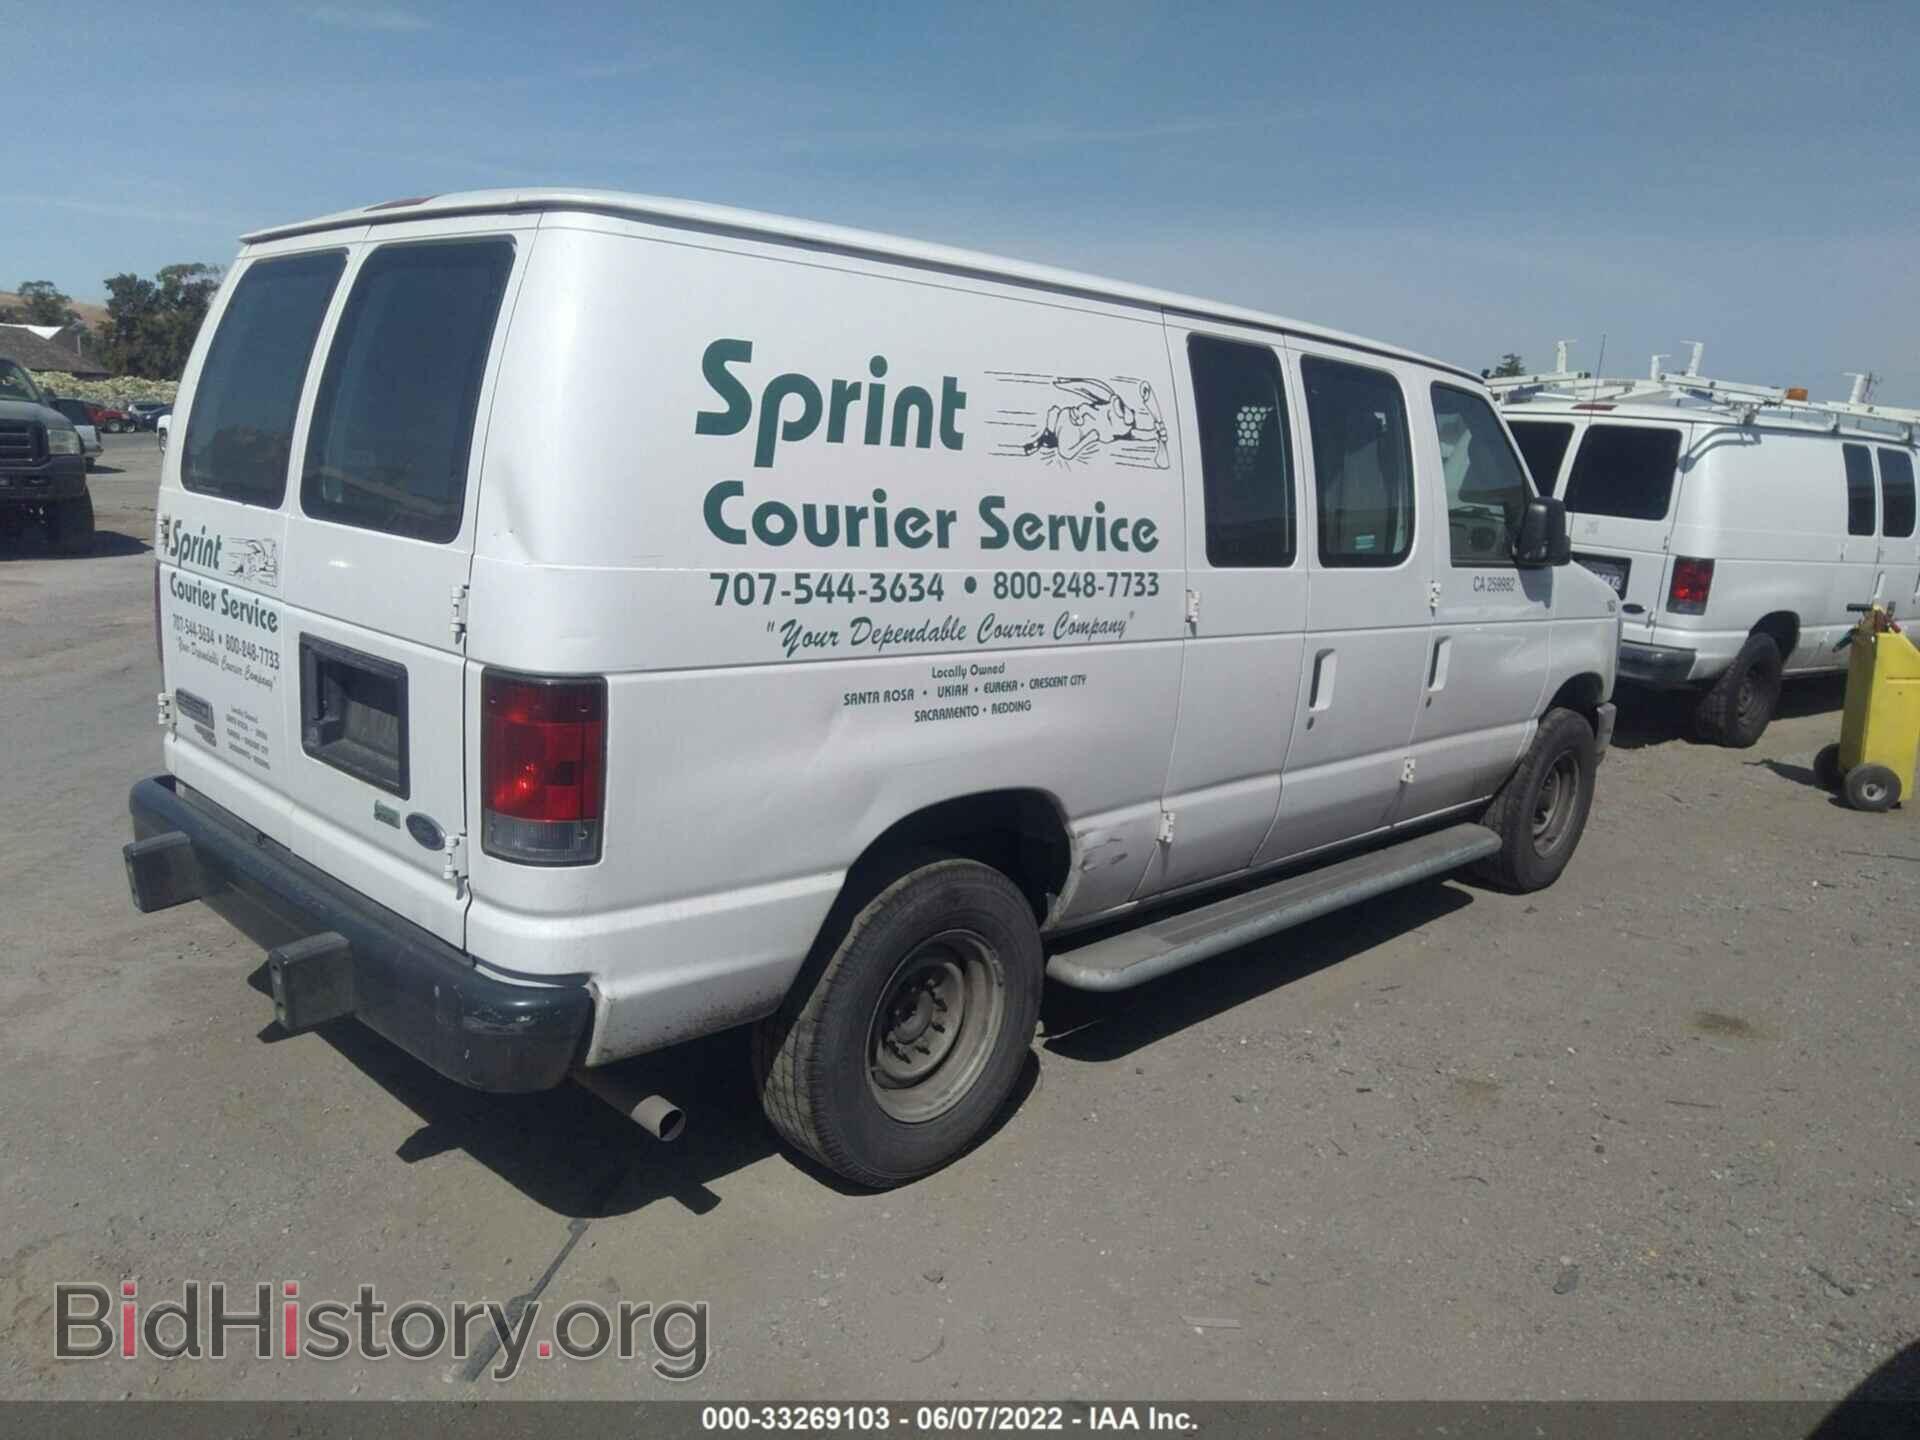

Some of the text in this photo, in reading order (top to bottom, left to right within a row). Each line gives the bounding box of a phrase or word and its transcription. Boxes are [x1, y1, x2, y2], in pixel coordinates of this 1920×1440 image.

[694, 337, 968, 469] Sprint
[702, 479, 1160, 553] Courier Service
[170, 519, 222, 570] Sprint
[170, 571, 278, 633] Courier Service
[708, 571, 1160, 607] 707-544-3634 800-248-7733
[1473, 575, 1485, 592] CA
[850, 614, 968, 653] Dependable
[976, 612, 1047, 645] Courier
[843, 674, 1087, 706] SANTA ROSA UKIAH EUREKA CRESCENT CITY
[932, 662, 1006, 680] Locally Owned
[914, 700, 1032, 722] SACRAMENTO REDDING
